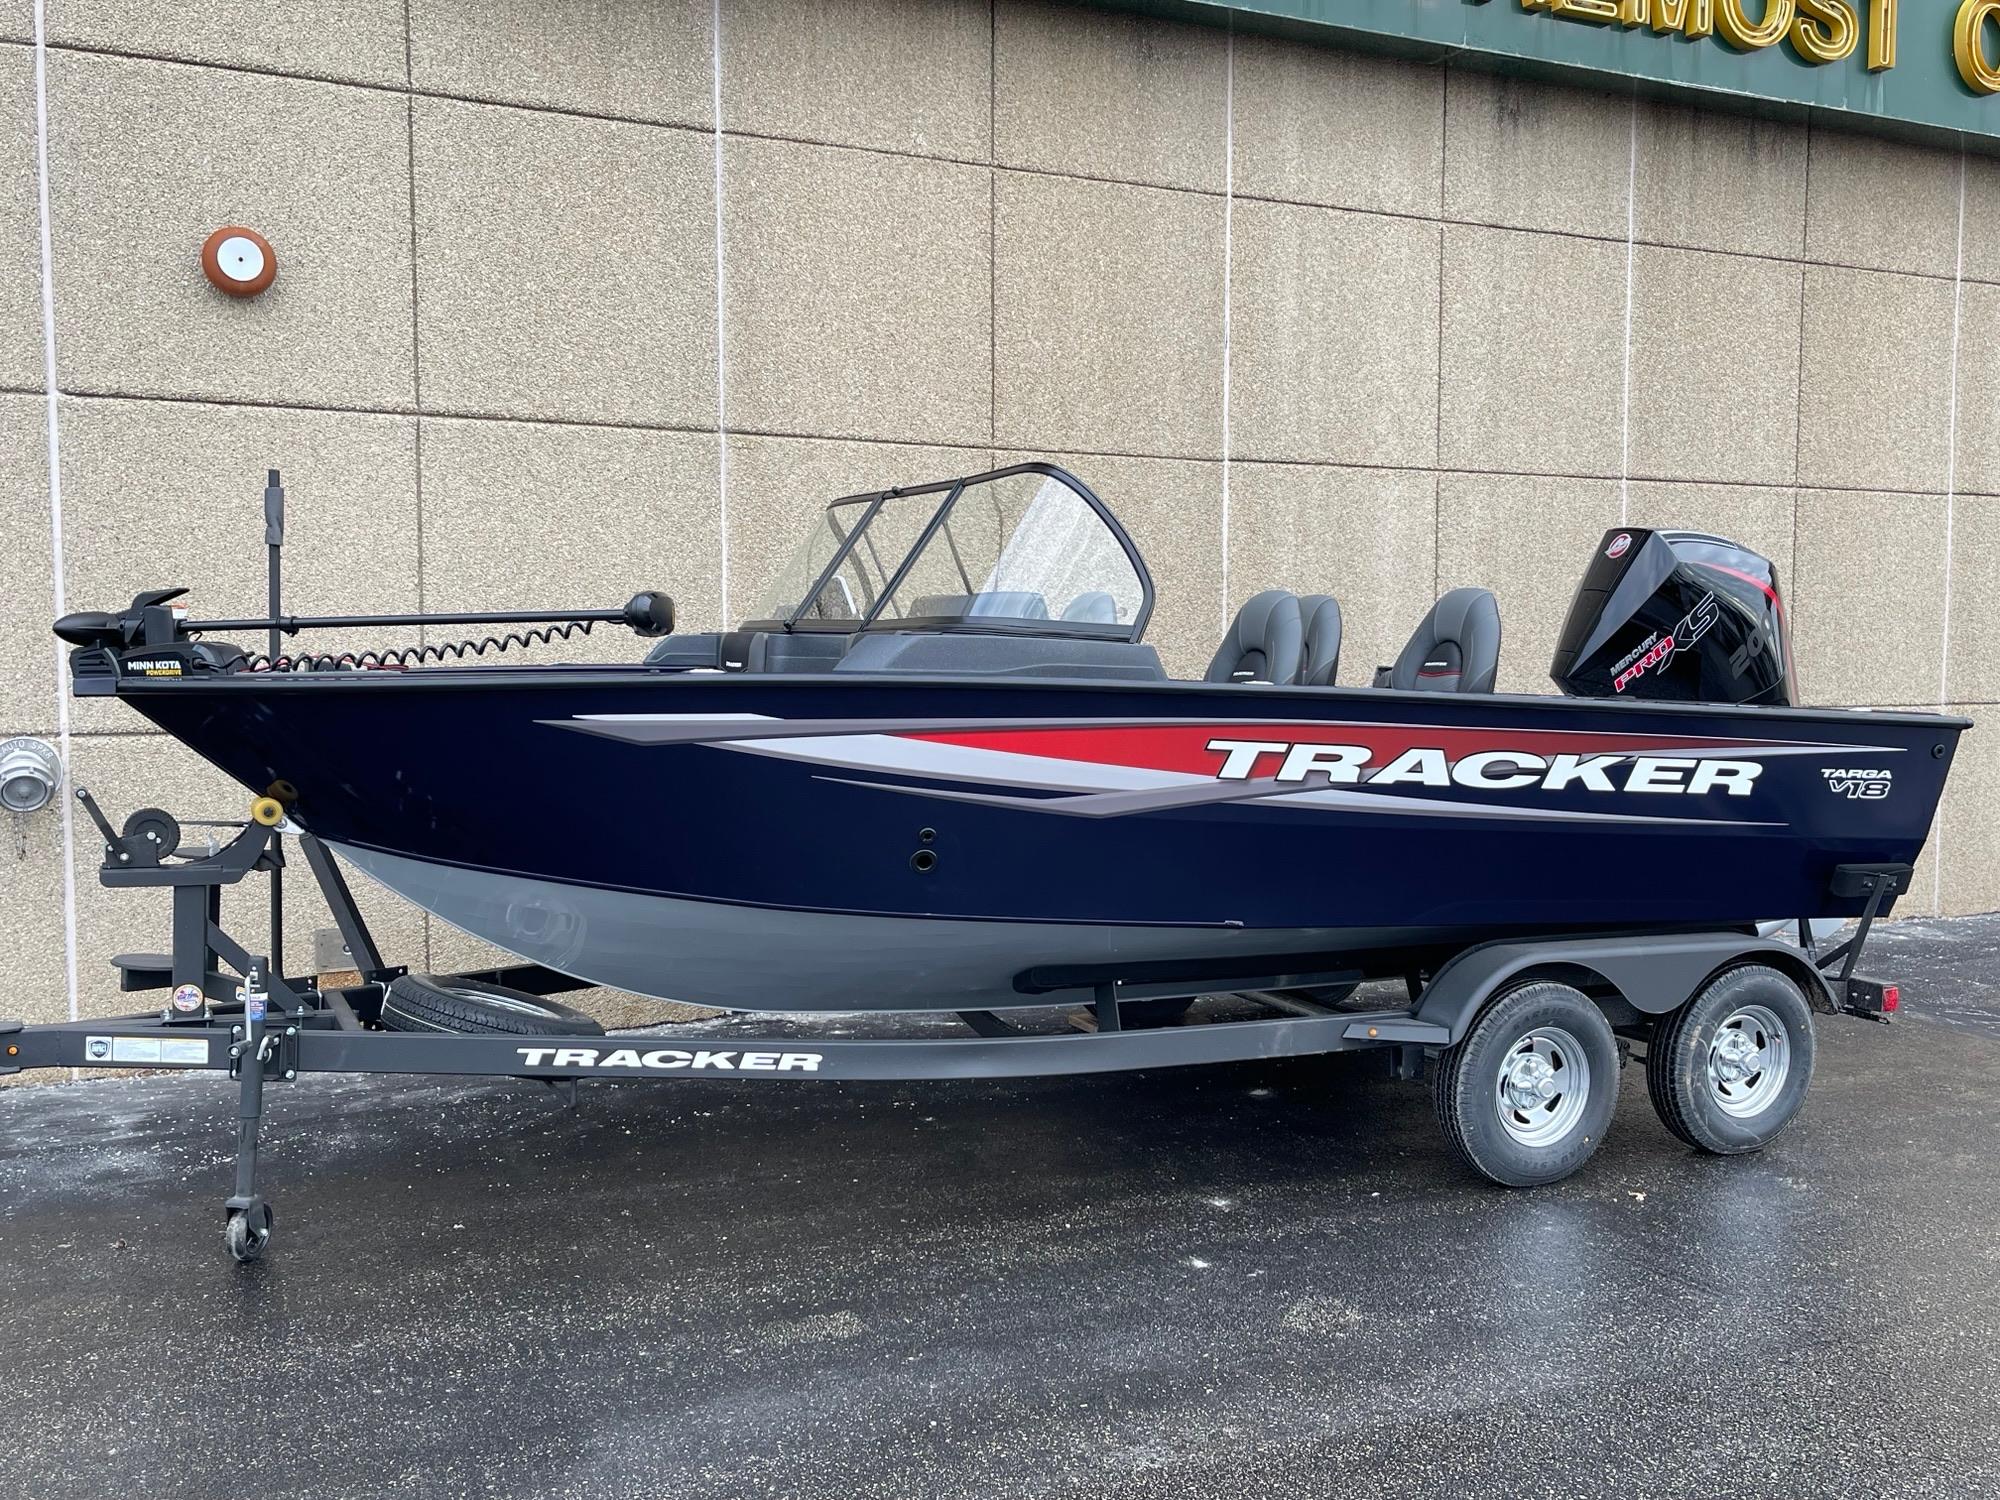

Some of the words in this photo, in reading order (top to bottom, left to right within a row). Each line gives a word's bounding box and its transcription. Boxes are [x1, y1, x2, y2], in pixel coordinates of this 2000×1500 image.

[127, 660, 154, 671] MINN
[155, 660, 182, 670] KOTA
[1610, 631, 1659, 677] MERCURY
[1614, 635, 1675, 693] PRO
[1204, 738, 1764, 796] TRACKER
[1820, 768, 1893, 779] TARGA
[1828, 779, 1892, 799] V18
[516, 1047, 824, 1072] TRACKER
